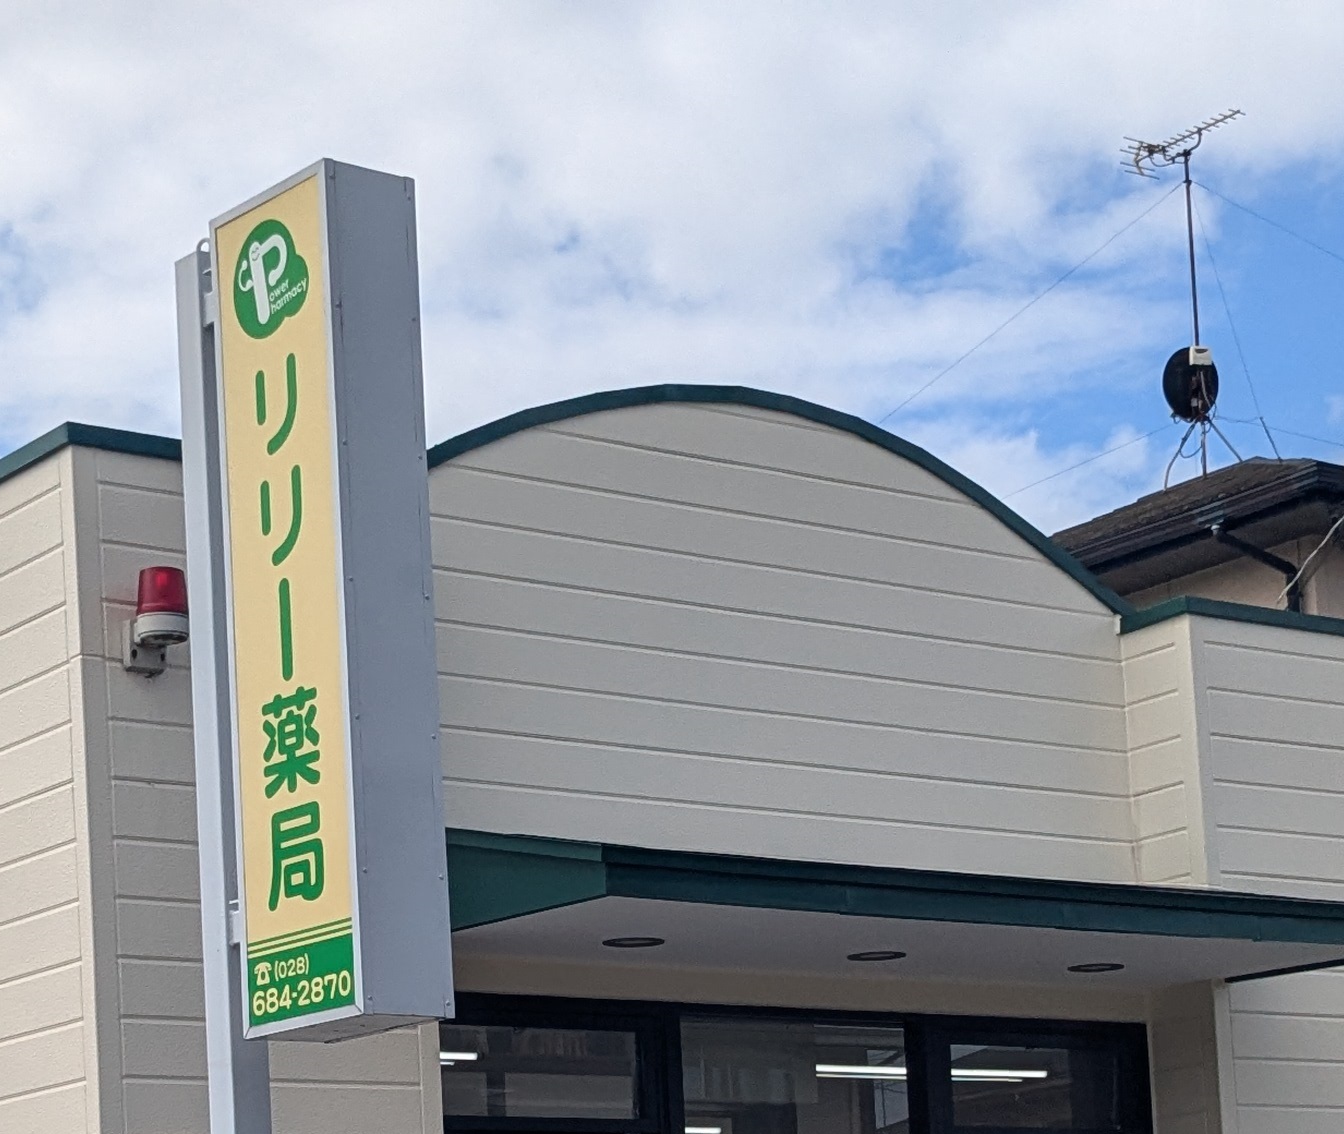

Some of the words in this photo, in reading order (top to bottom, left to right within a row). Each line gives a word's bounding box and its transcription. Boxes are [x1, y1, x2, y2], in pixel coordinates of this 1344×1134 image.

[255, 352, 325, 912] リリー薬局
[273, 953, 310, 979] (028)
[252, 969, 352, 1017] 684-2870
